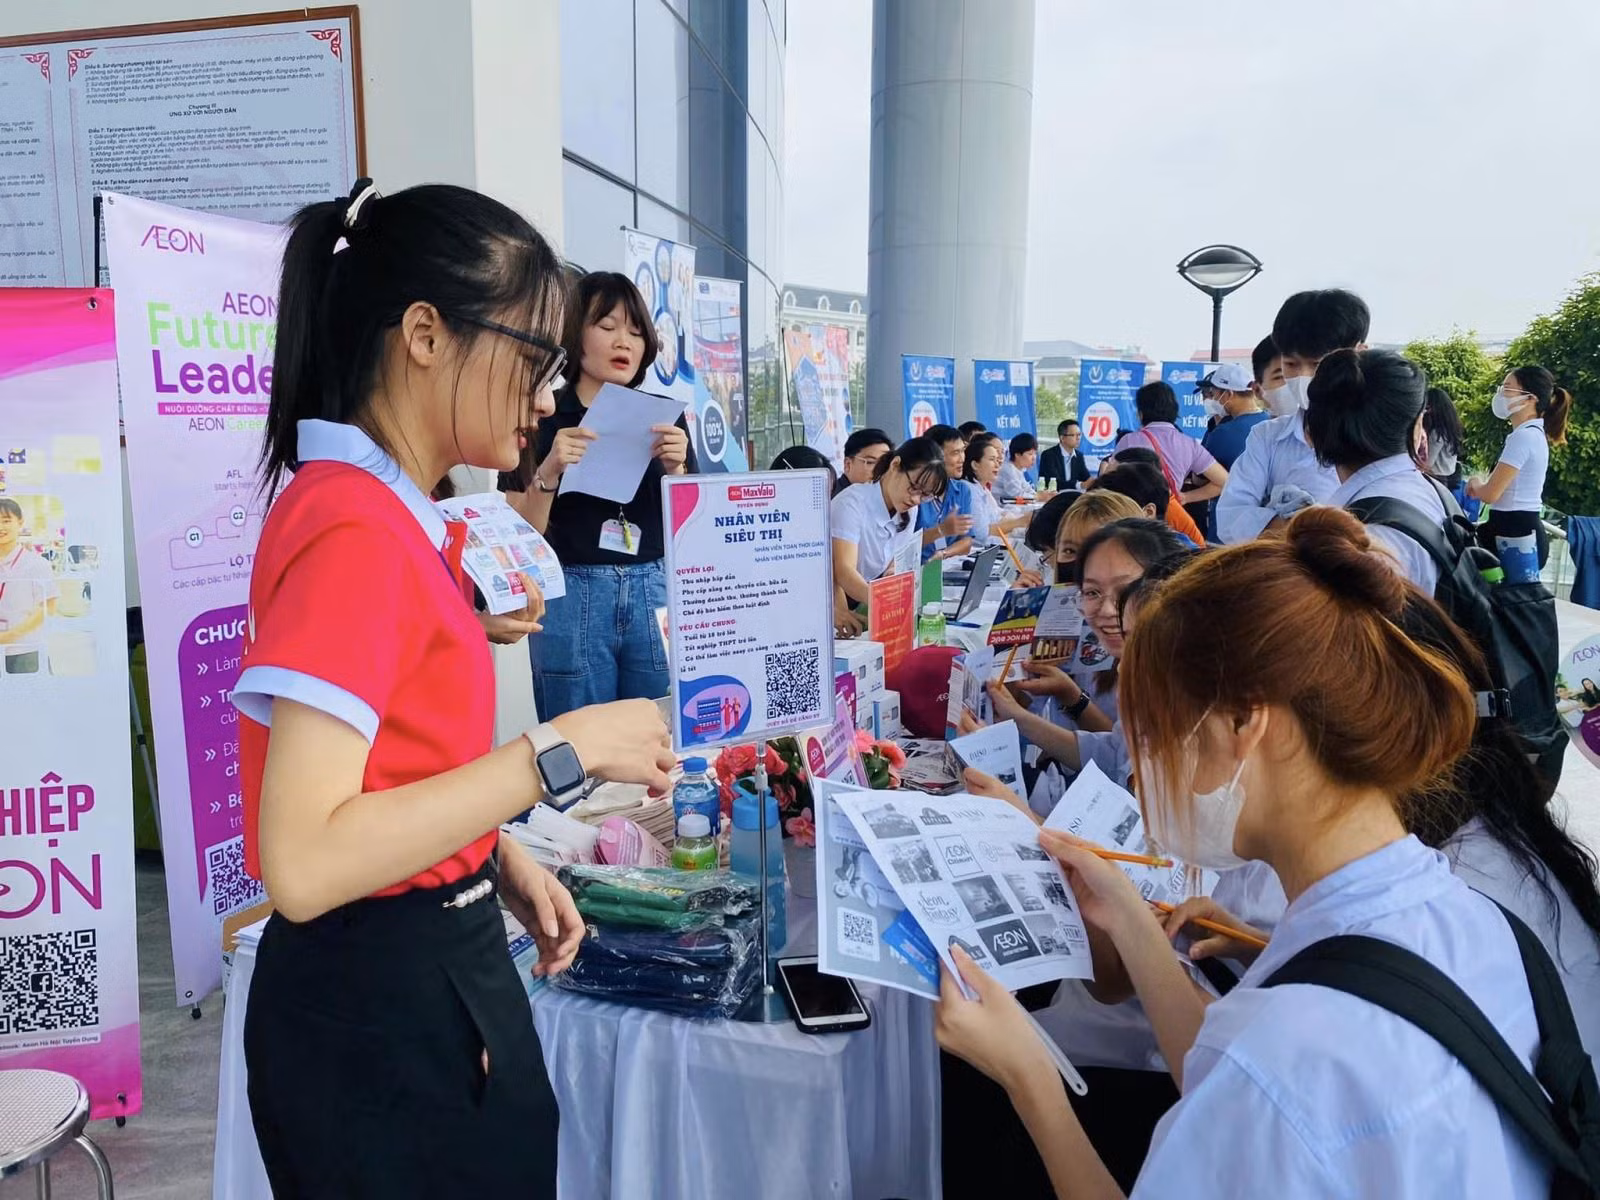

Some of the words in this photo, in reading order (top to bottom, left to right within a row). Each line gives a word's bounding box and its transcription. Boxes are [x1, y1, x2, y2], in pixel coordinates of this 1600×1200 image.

[189, 418, 224, 431] AEON
[1088, 416, 1112, 438] 70
[227, 470, 242, 479] AFL
[715, 512, 754, 528] NHÂN
[759, 509, 790, 522] VIÊN
[189, 533, 199, 541] G1
[725, 531, 755, 544] SIÊU
[760, 529, 782, 542] THỊ
[679, 624, 693, 632] YÊU
[695, 621, 709, 630] CẦU
[712, 619, 736, 627] CHUNG
